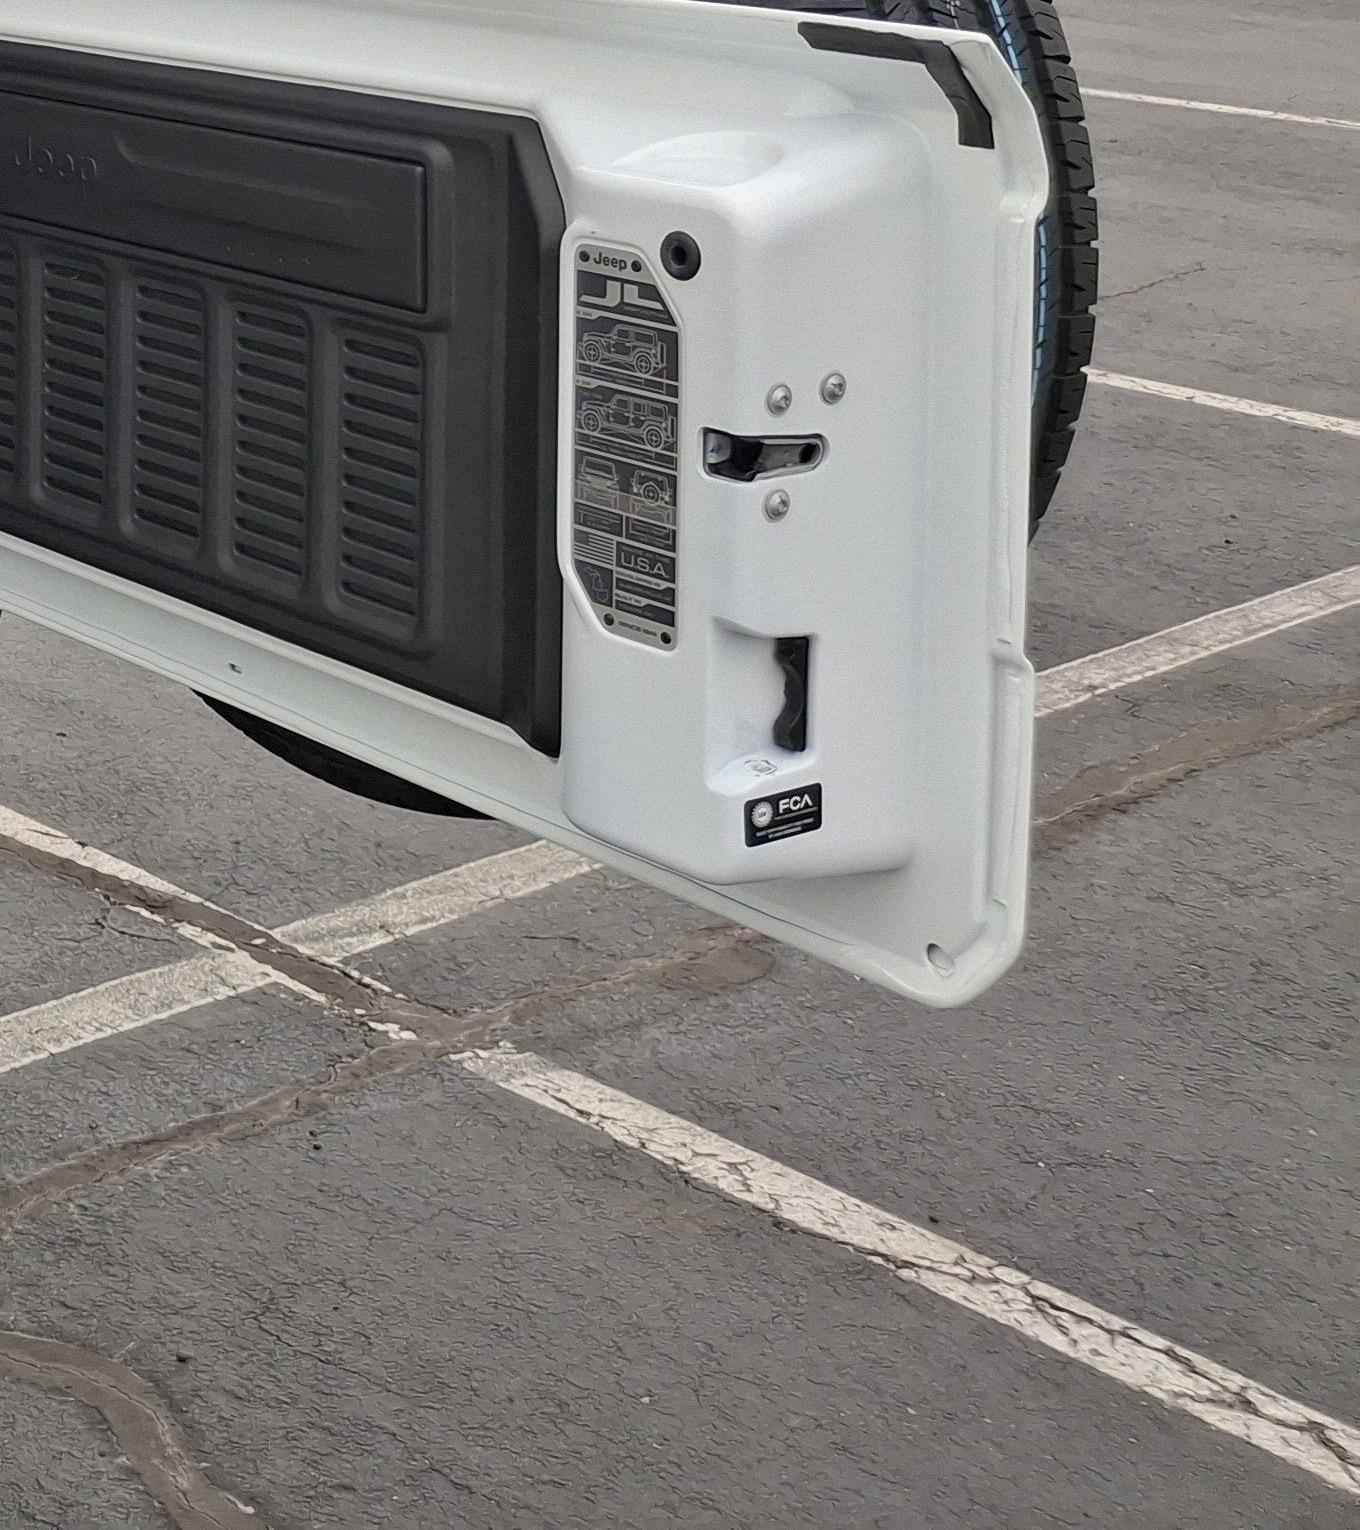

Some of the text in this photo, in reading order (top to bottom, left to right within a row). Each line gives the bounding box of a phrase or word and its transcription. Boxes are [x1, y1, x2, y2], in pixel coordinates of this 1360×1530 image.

[593, 252, 628, 272] Jeep
[579, 279, 666, 311] JL
[778, 793, 813, 814] FCA
